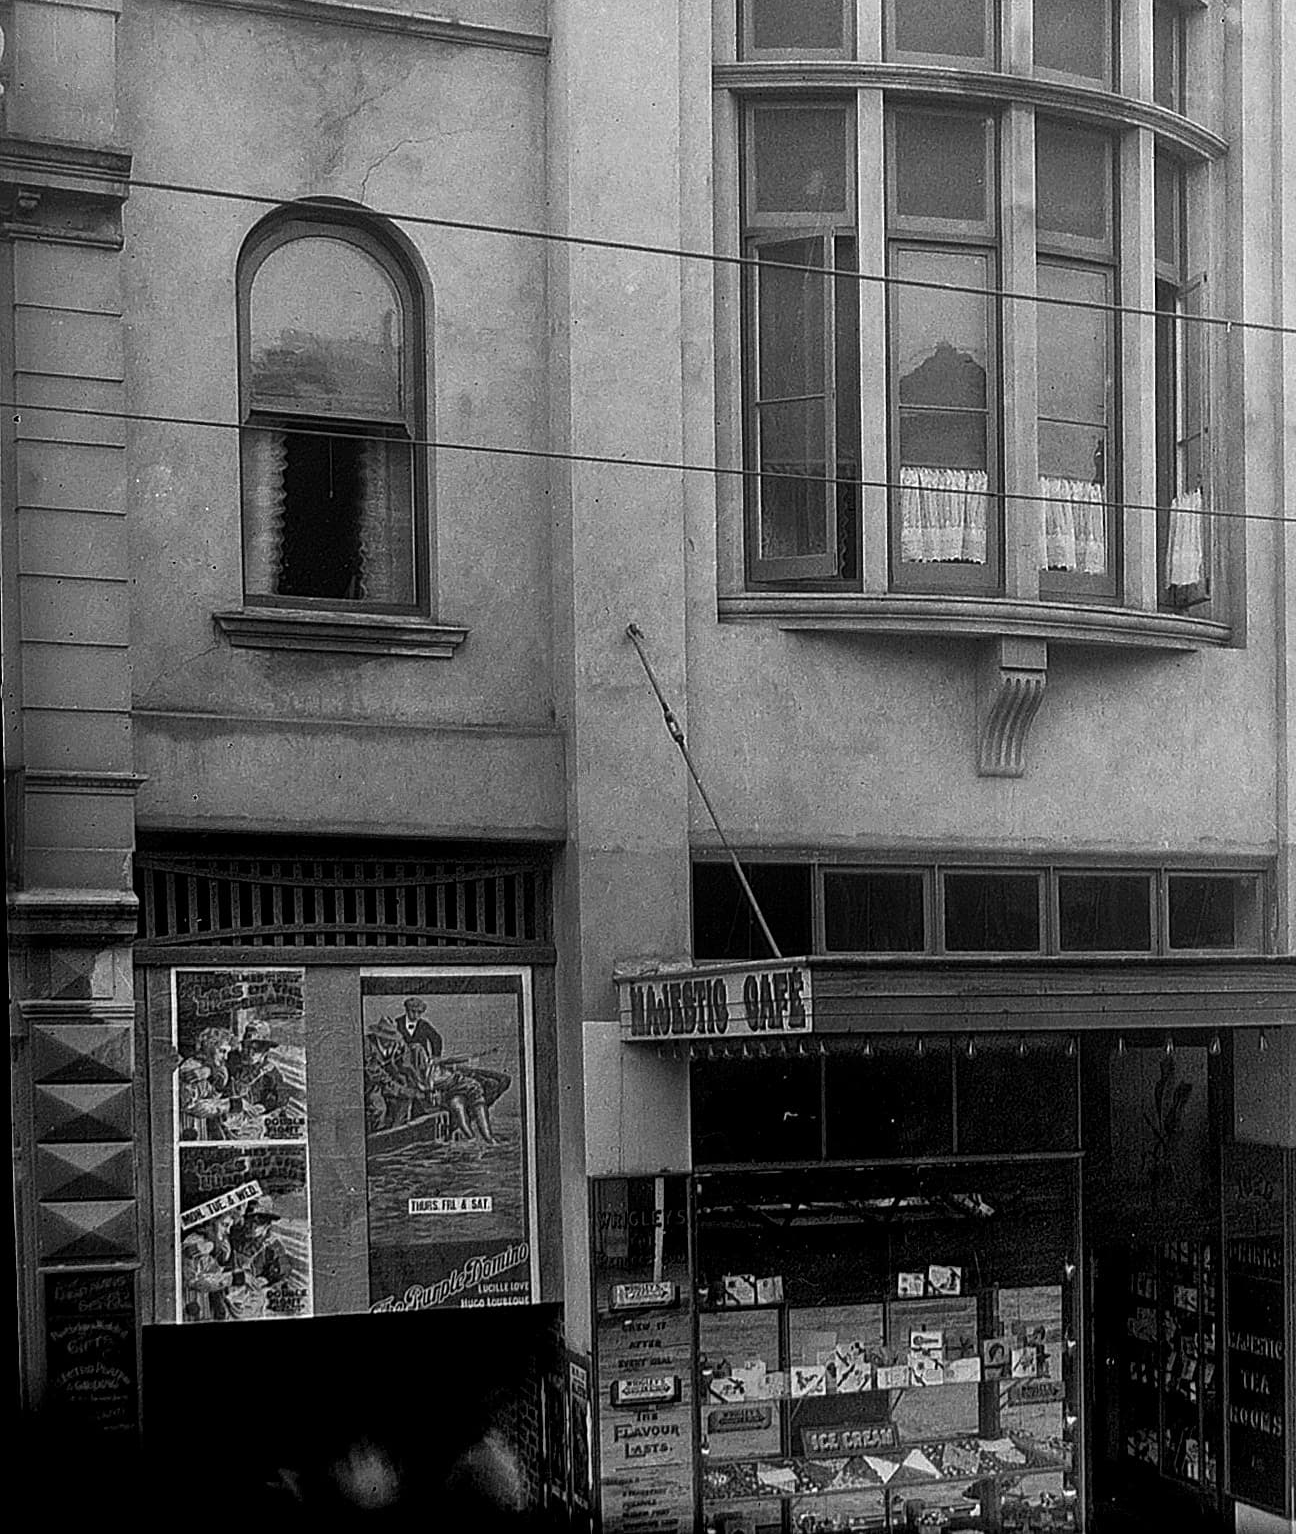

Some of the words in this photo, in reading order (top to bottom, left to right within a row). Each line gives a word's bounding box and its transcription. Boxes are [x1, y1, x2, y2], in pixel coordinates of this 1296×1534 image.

[630, 977, 729, 1037] MAJESTIC
[460, 1198, 468, 1211] &
[404, 1268, 466, 1312] Purple
[463, 1242, 529, 1289] Domino
[510, 1281, 530, 1292] LOVE
[629, 1339, 662, 1349] AFTER
[1228, 1330, 1284, 1362] MAJESTIC
[1240, 1369, 1271, 1396] TEA
[614, 1423, 680, 1443] FLAVOUR
[1228, 1403, 1283, 1438] ROOMS
[809, 1433, 840, 1452] ICE
[841, 1427, 894, 1450] CREAM
